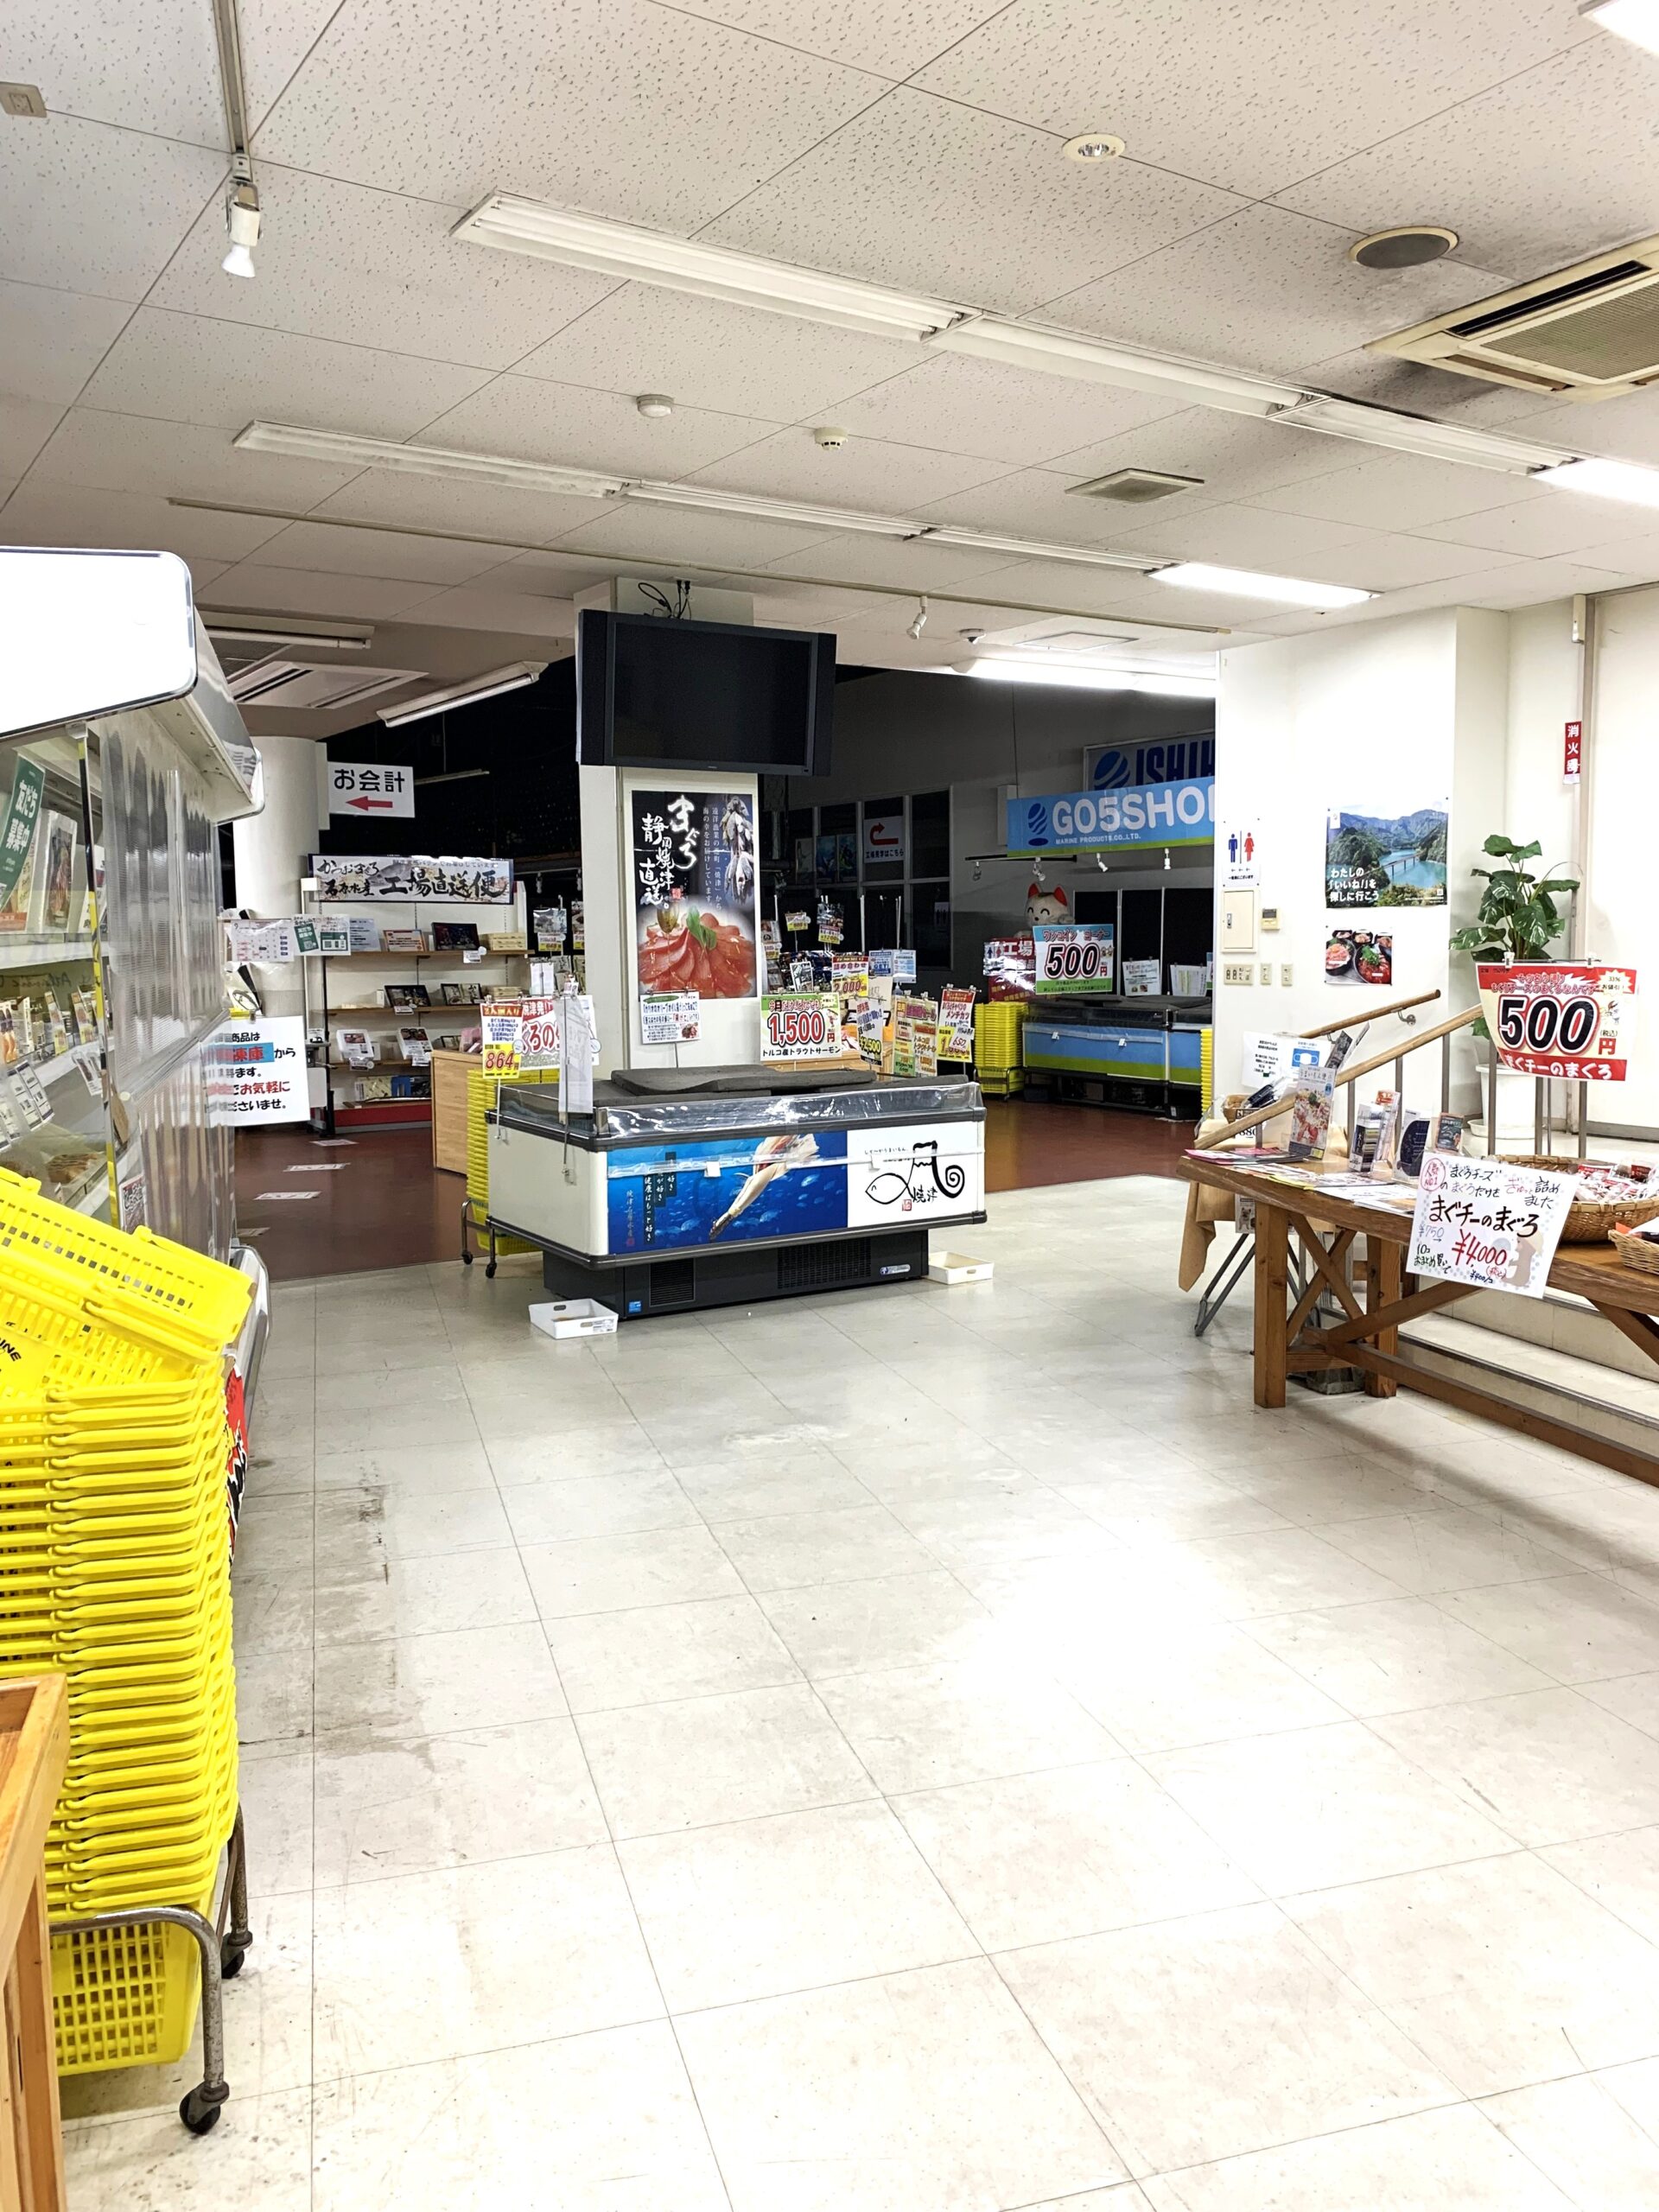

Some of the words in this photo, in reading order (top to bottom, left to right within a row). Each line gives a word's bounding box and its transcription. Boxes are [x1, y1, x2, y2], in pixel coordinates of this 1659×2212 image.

[334, 769, 405, 793] お会計
[15, 779, 38, 818] 友だち
[1052, 785, 1215, 836] GO5SHO
[6, 818, 30, 855] 募集中
[667, 795, 700, 870] まぐろ
[378, 868, 507, 899] 工場直送便
[1331, 868, 1364, 878] わたしの
[1330, 891, 1379, 902] 探しに行こう
[1043, 928, 1077, 942] ワンコイン
[1084, 928, 1110, 941] コーナー
[1004, 940, 1036, 957] 工場
[1046, 943, 1100, 979] 500
[767, 1011, 825, 1048] 1,500
[1498, 995, 1599, 1055] 500
[827, 1033, 836, 1043] 円
[1599, 1038, 1617, 1055] 円
[485, 1051, 513, 1070] 864
[762, 1046, 841, 1057] トルコ産トラウトサーモン
[1429, 1194, 1540, 1238] まぐチーのまぐろ
[0, 1338, 22, 1362] INE
